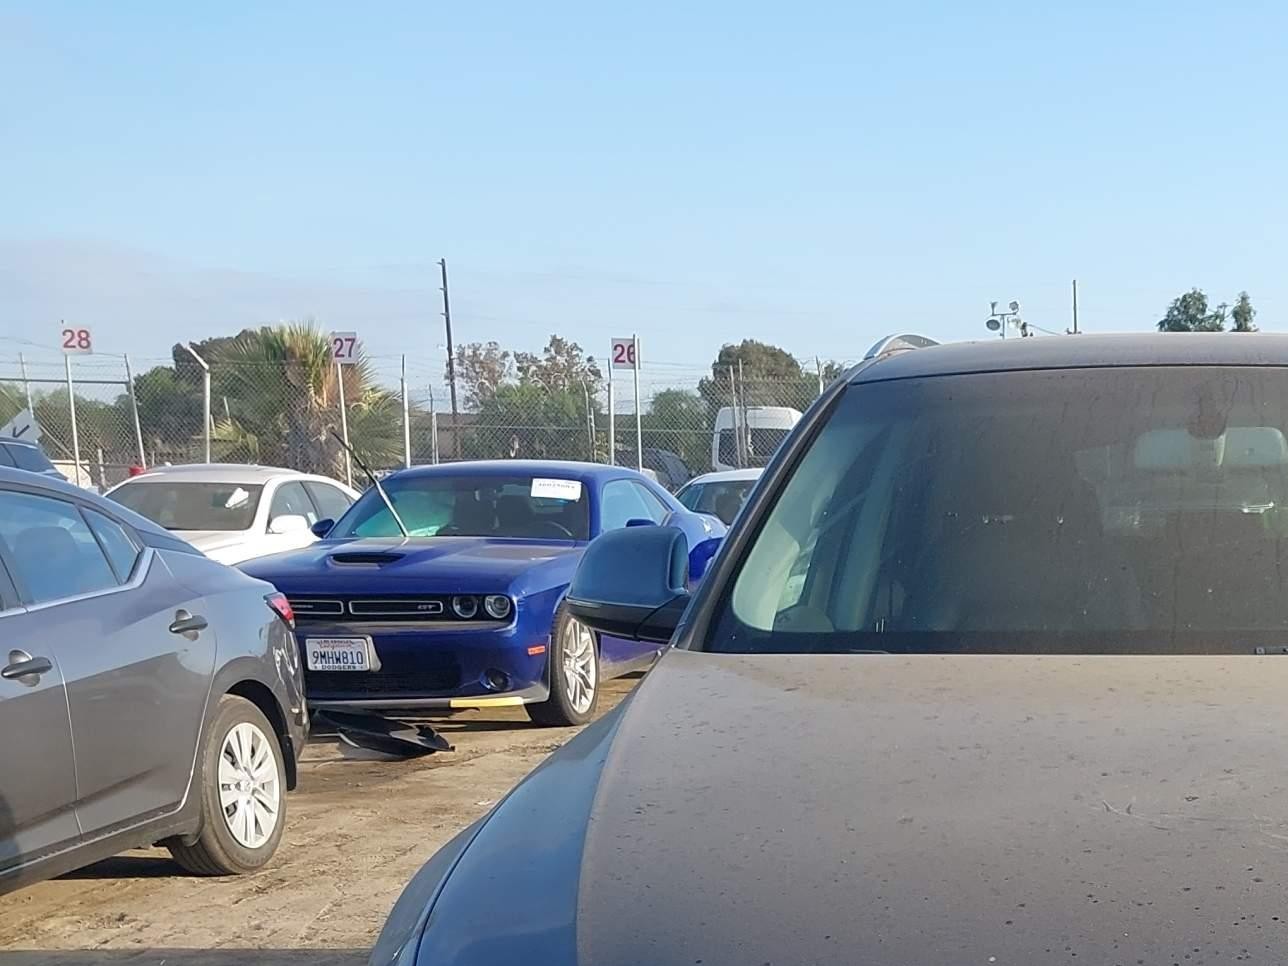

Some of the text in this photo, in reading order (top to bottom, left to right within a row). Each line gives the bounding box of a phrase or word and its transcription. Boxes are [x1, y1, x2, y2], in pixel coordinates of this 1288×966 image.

[61, 328, 91, 349] 28
[333, 337, 357, 358] 27
[312, 650, 364, 665] 9MHW810
